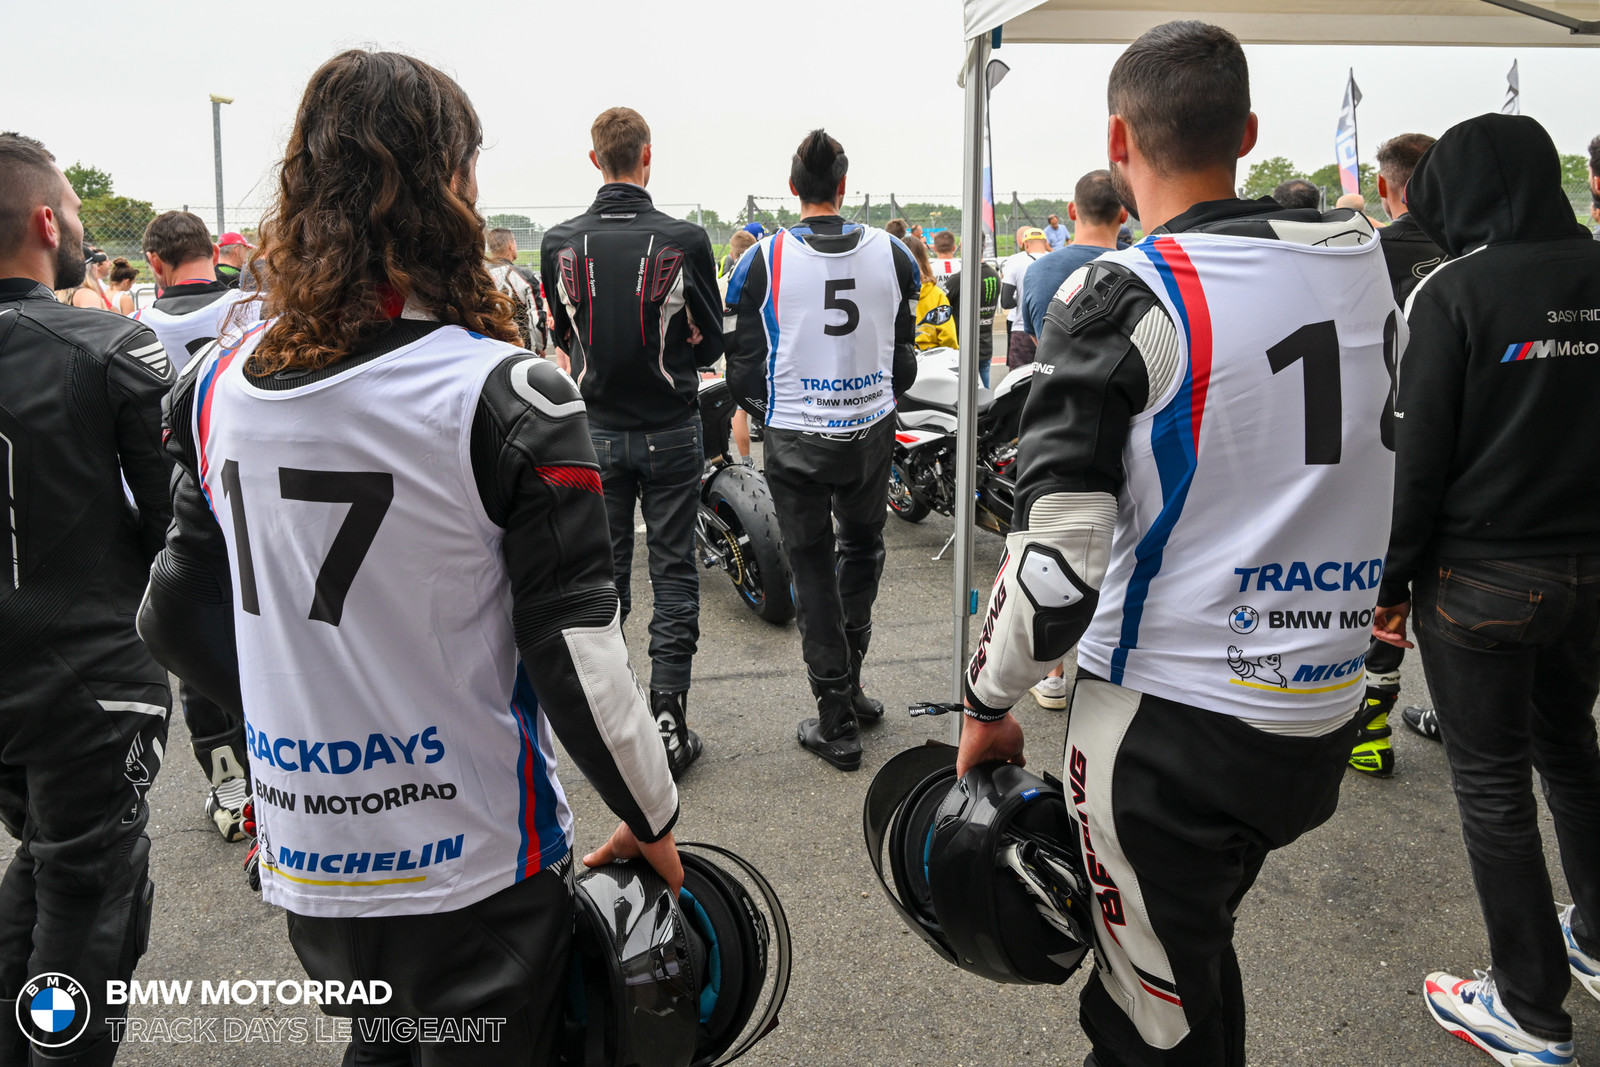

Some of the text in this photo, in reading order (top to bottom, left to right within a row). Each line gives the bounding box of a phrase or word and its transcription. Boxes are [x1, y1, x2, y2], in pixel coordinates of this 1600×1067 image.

[824, 278, 860, 336] 5
[801, 371, 883, 392] TRACKDAYS
[816, 390, 884, 407] BMW MOTORRAD
[220, 458, 394, 627] 17
[1234, 558, 1387, 593] TRACKD
[1268, 611, 1332, 629] BMW
[245, 726, 445, 775] RACKDAYS
[255, 777, 457, 815] BMW MOTORRAD
[278, 834, 464, 874] MICHELIN
